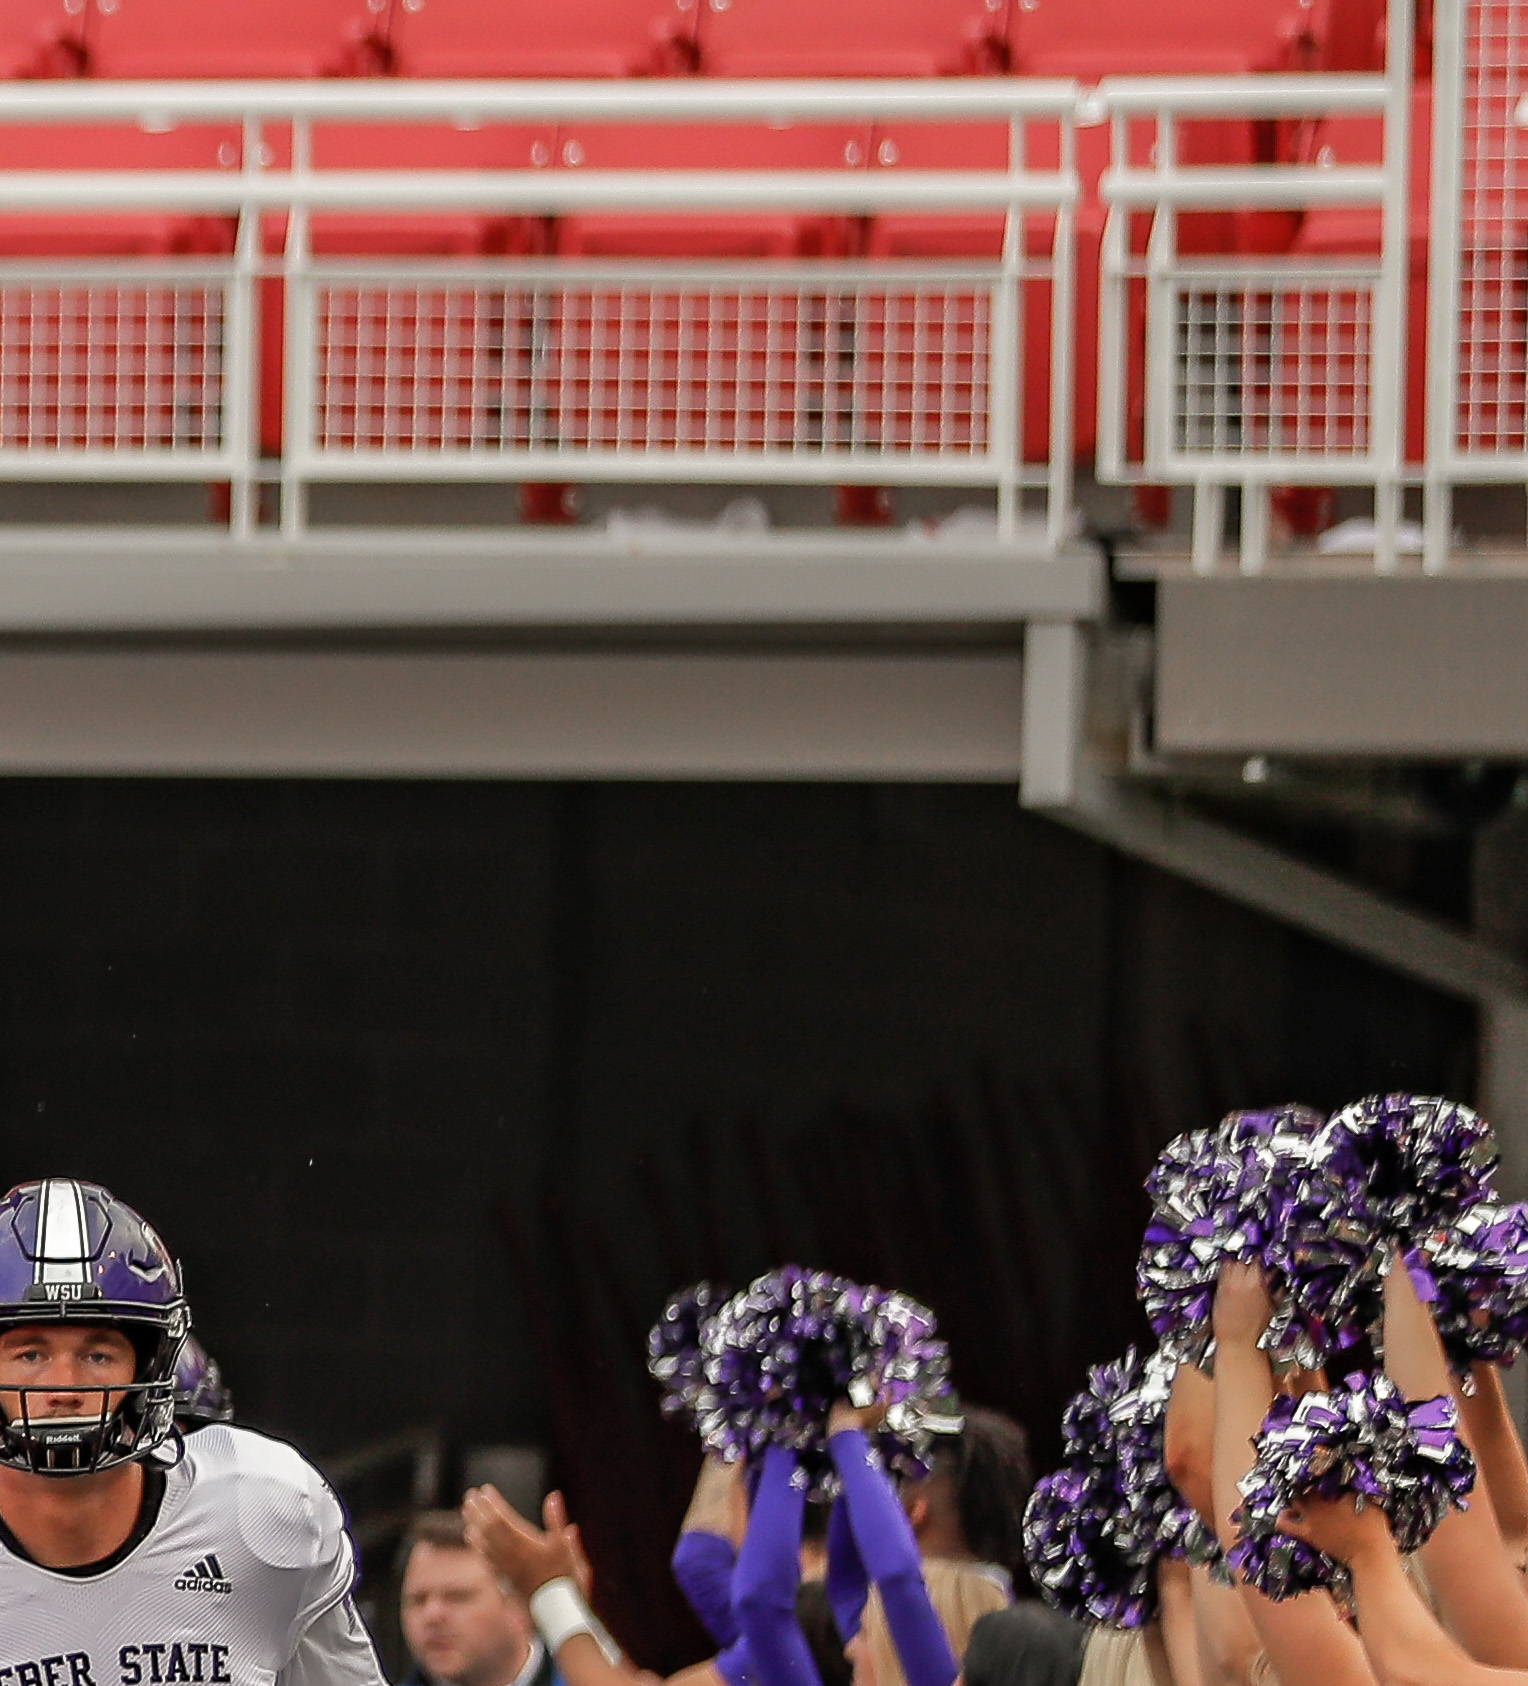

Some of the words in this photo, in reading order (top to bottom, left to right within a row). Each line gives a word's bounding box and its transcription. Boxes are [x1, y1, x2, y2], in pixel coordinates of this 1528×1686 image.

[45, 1284, 83, 1300] WSU
[173, 1576, 232, 1594] adidas
[118, 1643, 231, 1686] STATE
